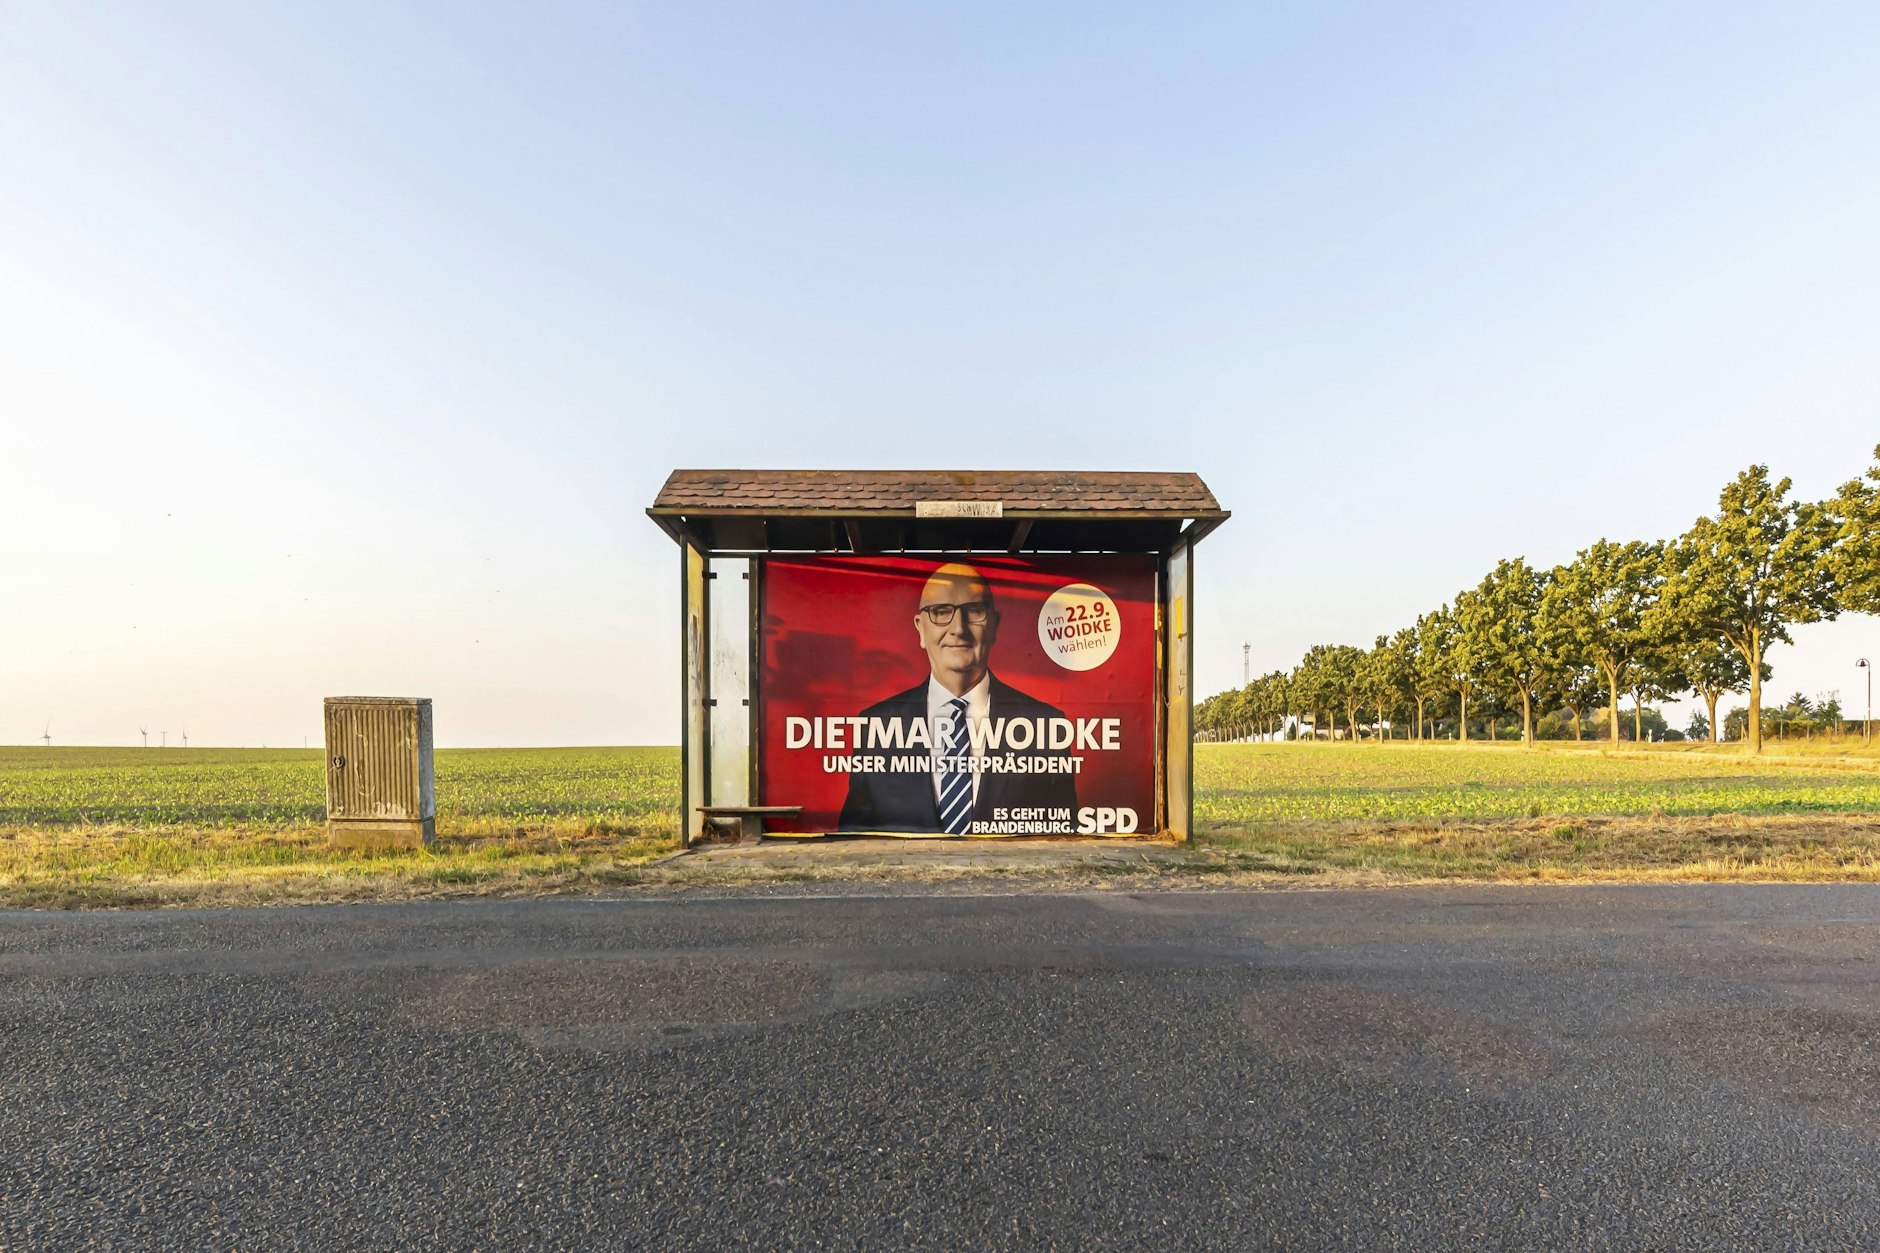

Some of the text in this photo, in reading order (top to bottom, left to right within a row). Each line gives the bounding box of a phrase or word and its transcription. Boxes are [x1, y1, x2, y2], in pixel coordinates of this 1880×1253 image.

[1046, 602, 1110, 626] Am 22.9.
[1047, 618, 1112, 642] WOIDKE
[1058, 636, 1107, 654] wählen!
[786, 716, 1121, 750] DIETMAR WOIDKE
[823, 752, 1084, 774] UNSER MINISTERPRÄSIDENT
[993, 807, 1071, 820] ES GEHT UM
[1076, 806, 1139, 834] SPD
[972, 821, 1075, 834] BRANDENBURG.
